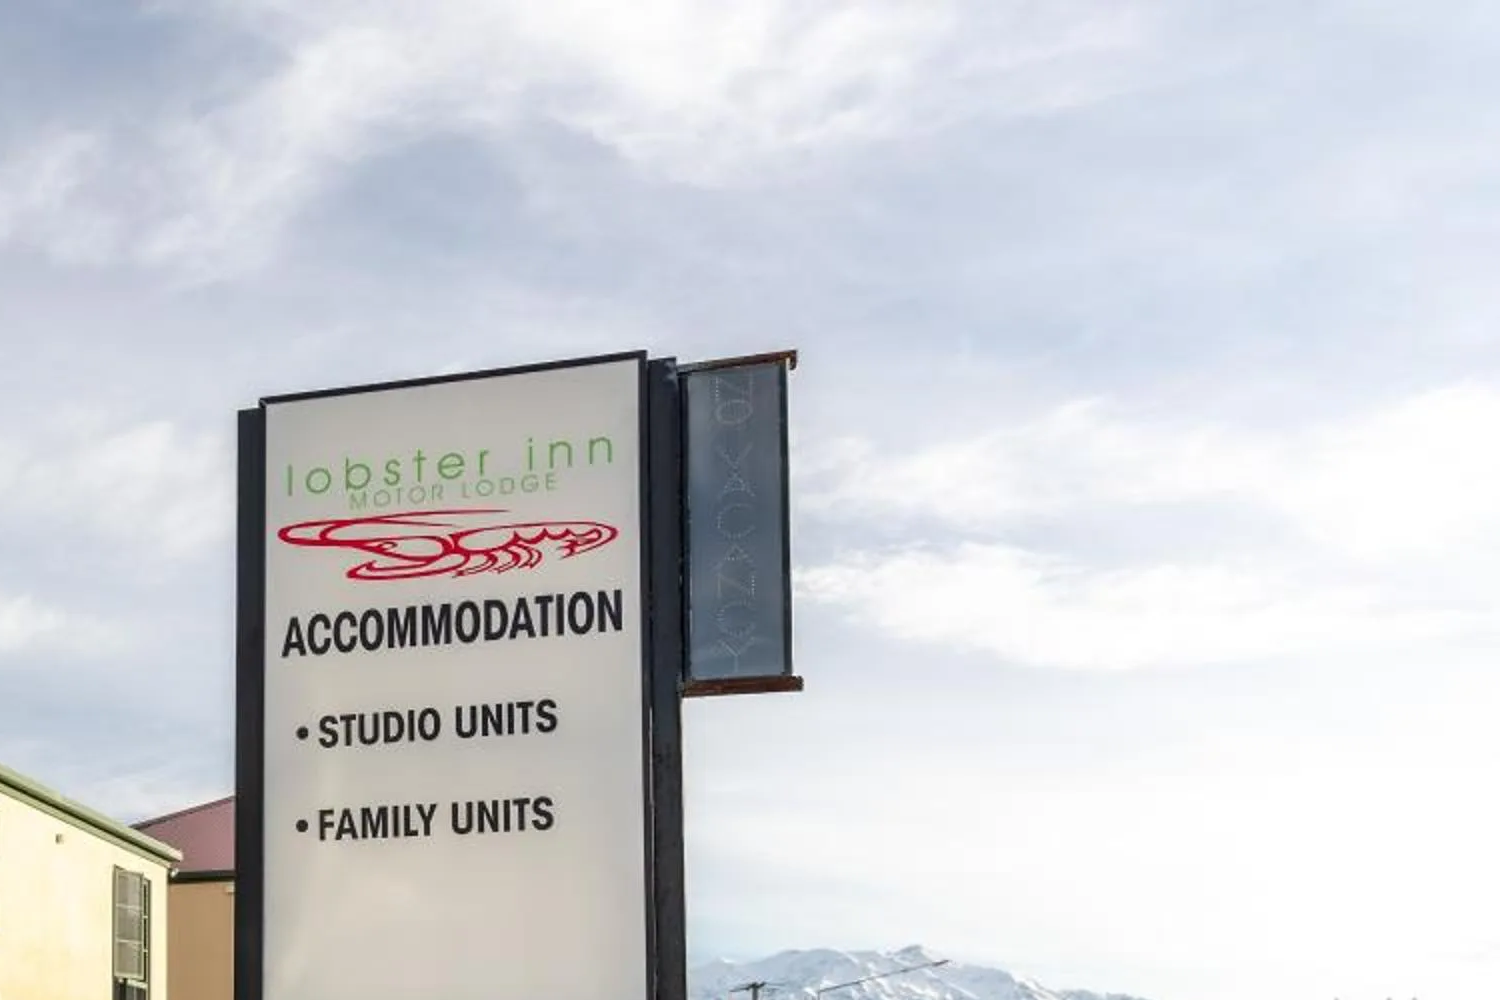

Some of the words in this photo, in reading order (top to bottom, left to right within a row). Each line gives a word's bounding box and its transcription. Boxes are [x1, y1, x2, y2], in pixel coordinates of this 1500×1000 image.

[286, 447, 490, 497] lobster
[527, 435, 614, 472] inn
[349, 483, 444, 511] MOTOR
[461, 471, 559, 499] LODGE
[281, 588, 623, 658] ACCOMMODATION
[318, 707, 442, 749] STUDIO
[455, 698, 559, 739] UNITS
[318, 803, 438, 842] FAMILY
[451, 796, 555, 835] UNITS
